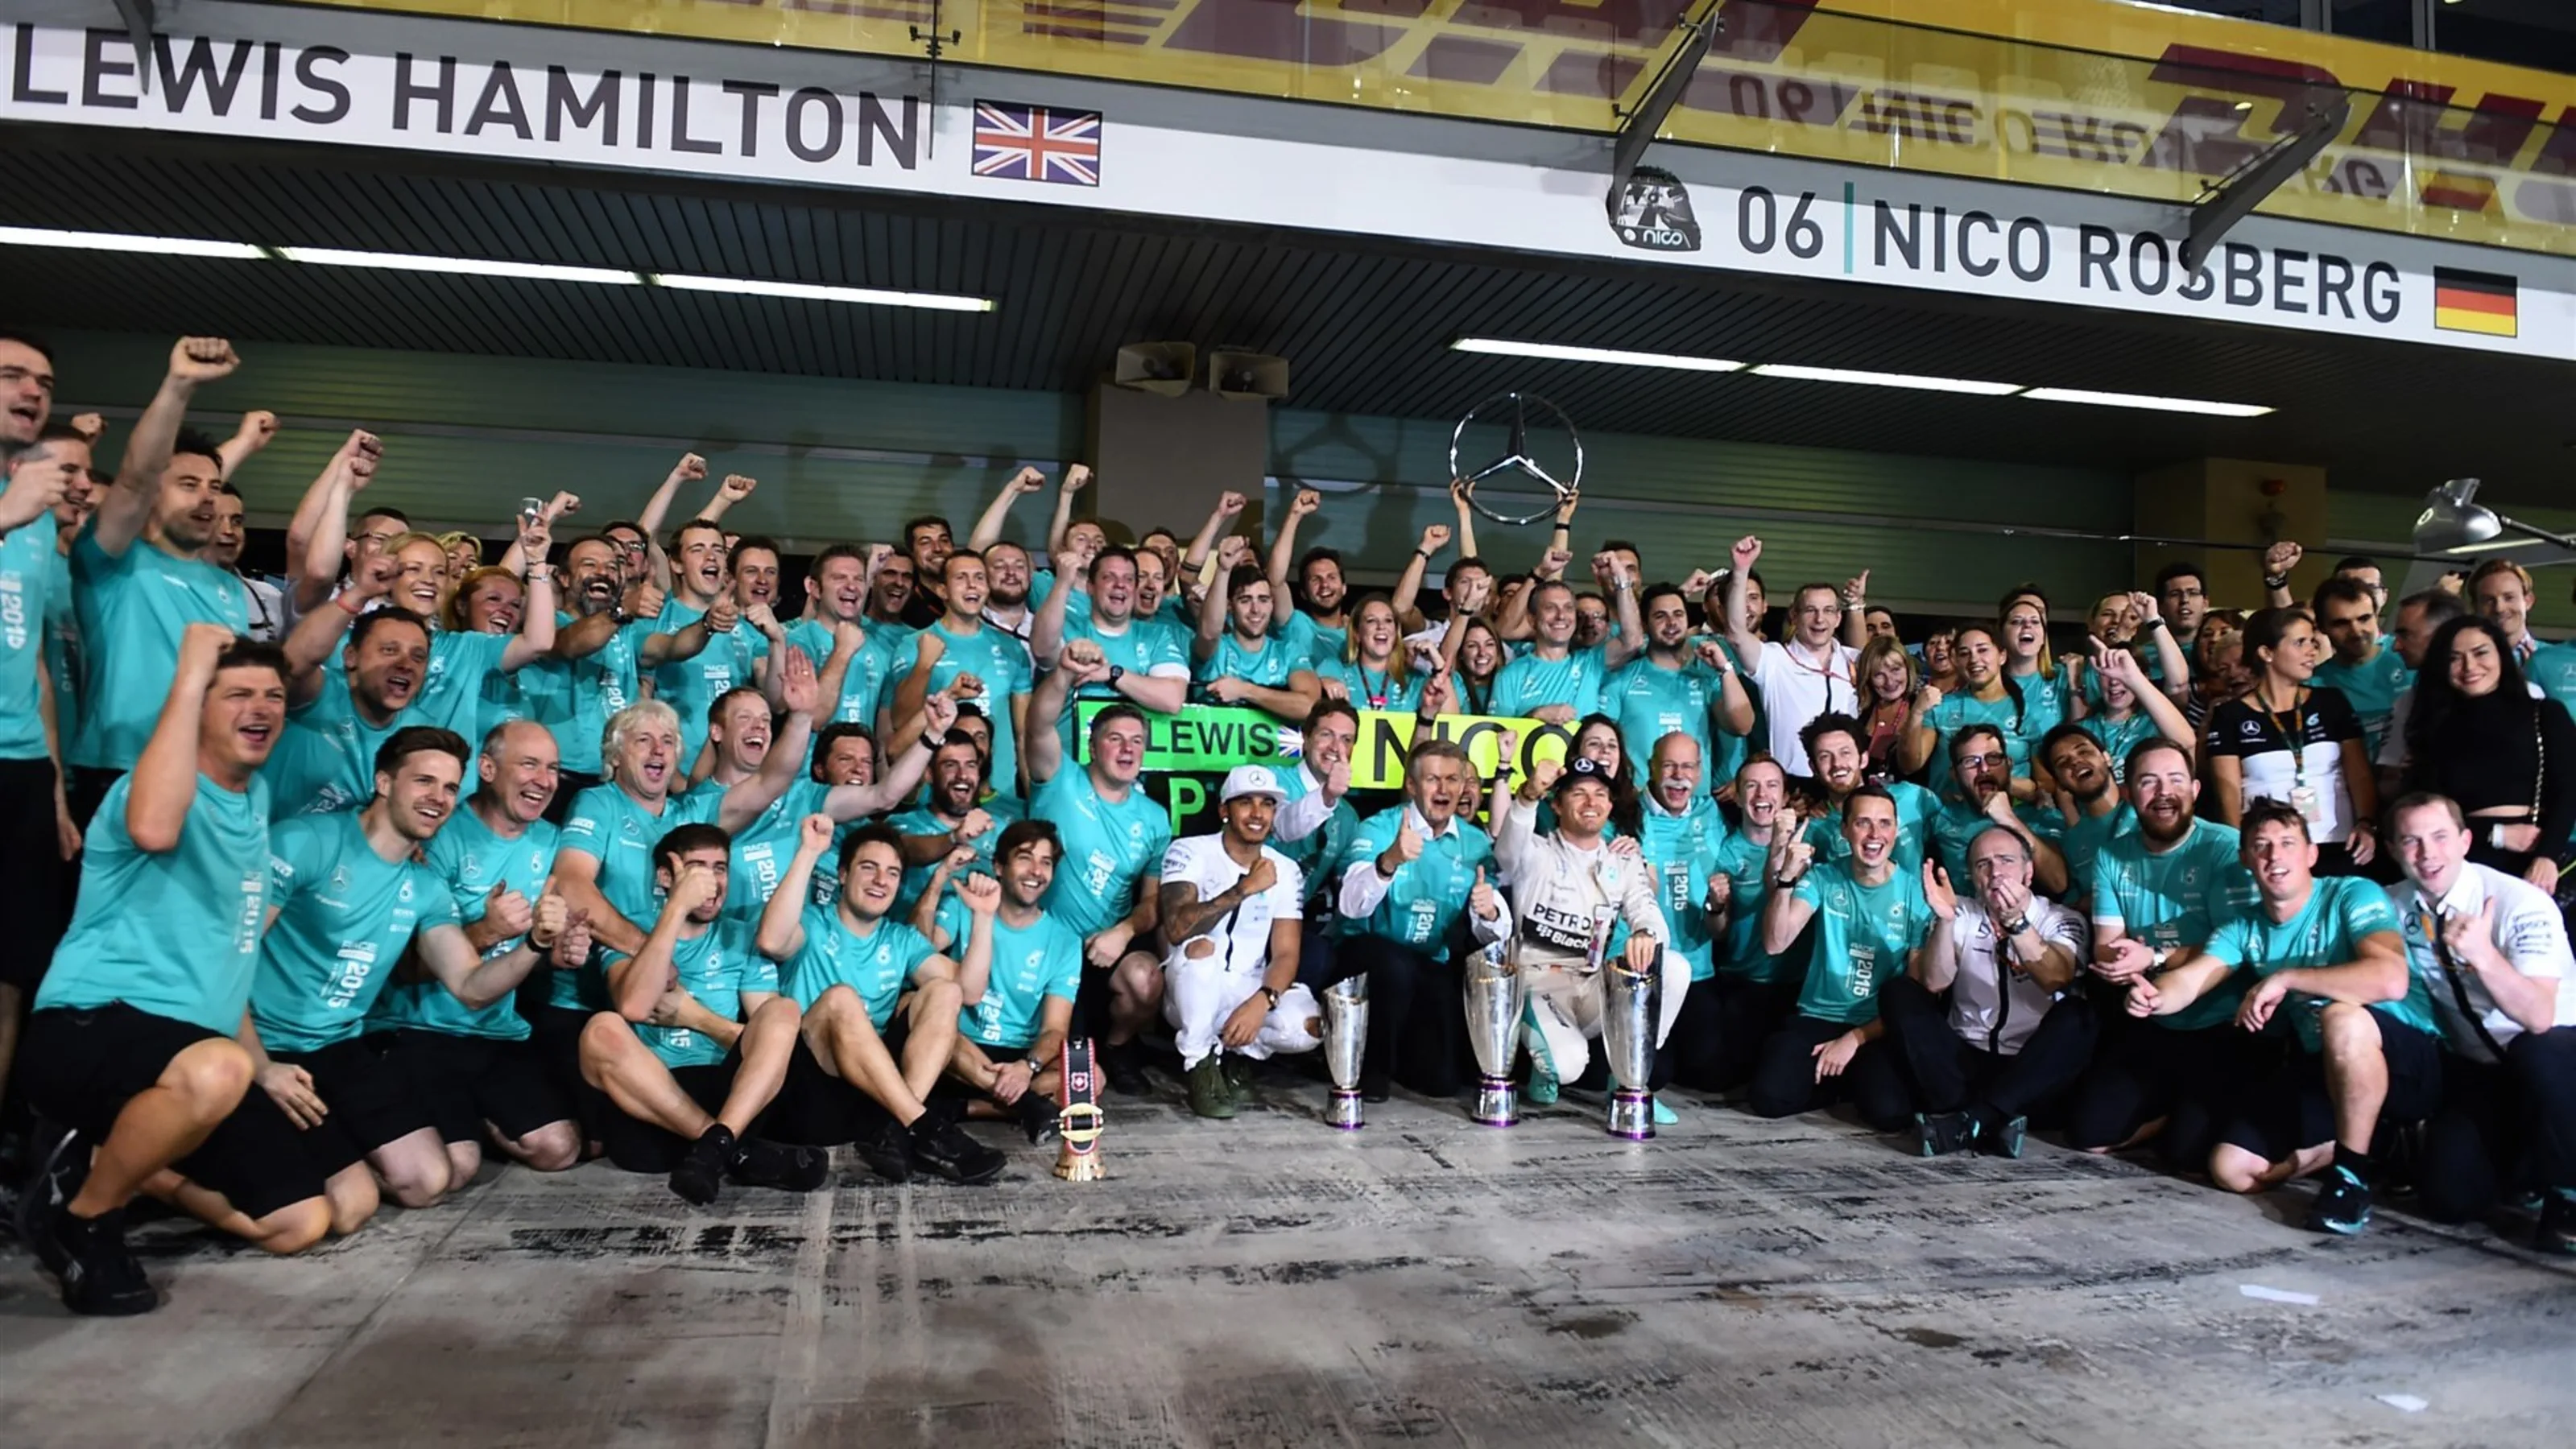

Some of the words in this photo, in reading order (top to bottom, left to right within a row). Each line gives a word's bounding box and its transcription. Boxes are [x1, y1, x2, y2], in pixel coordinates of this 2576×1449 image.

[12, 23, 350, 124] LEWIS
[392, 52, 919, 171] HAMILTON
[1738, 184, 1824, 259] 06
[1873, 198, 2051, 283] NICO
[2079, 222, 2401, 324] ROSBERG
[1147, 719, 1276, 757] LEWIS
[1169, 777, 1206, 836] P
[1852, 960, 1873, 998] 2015
